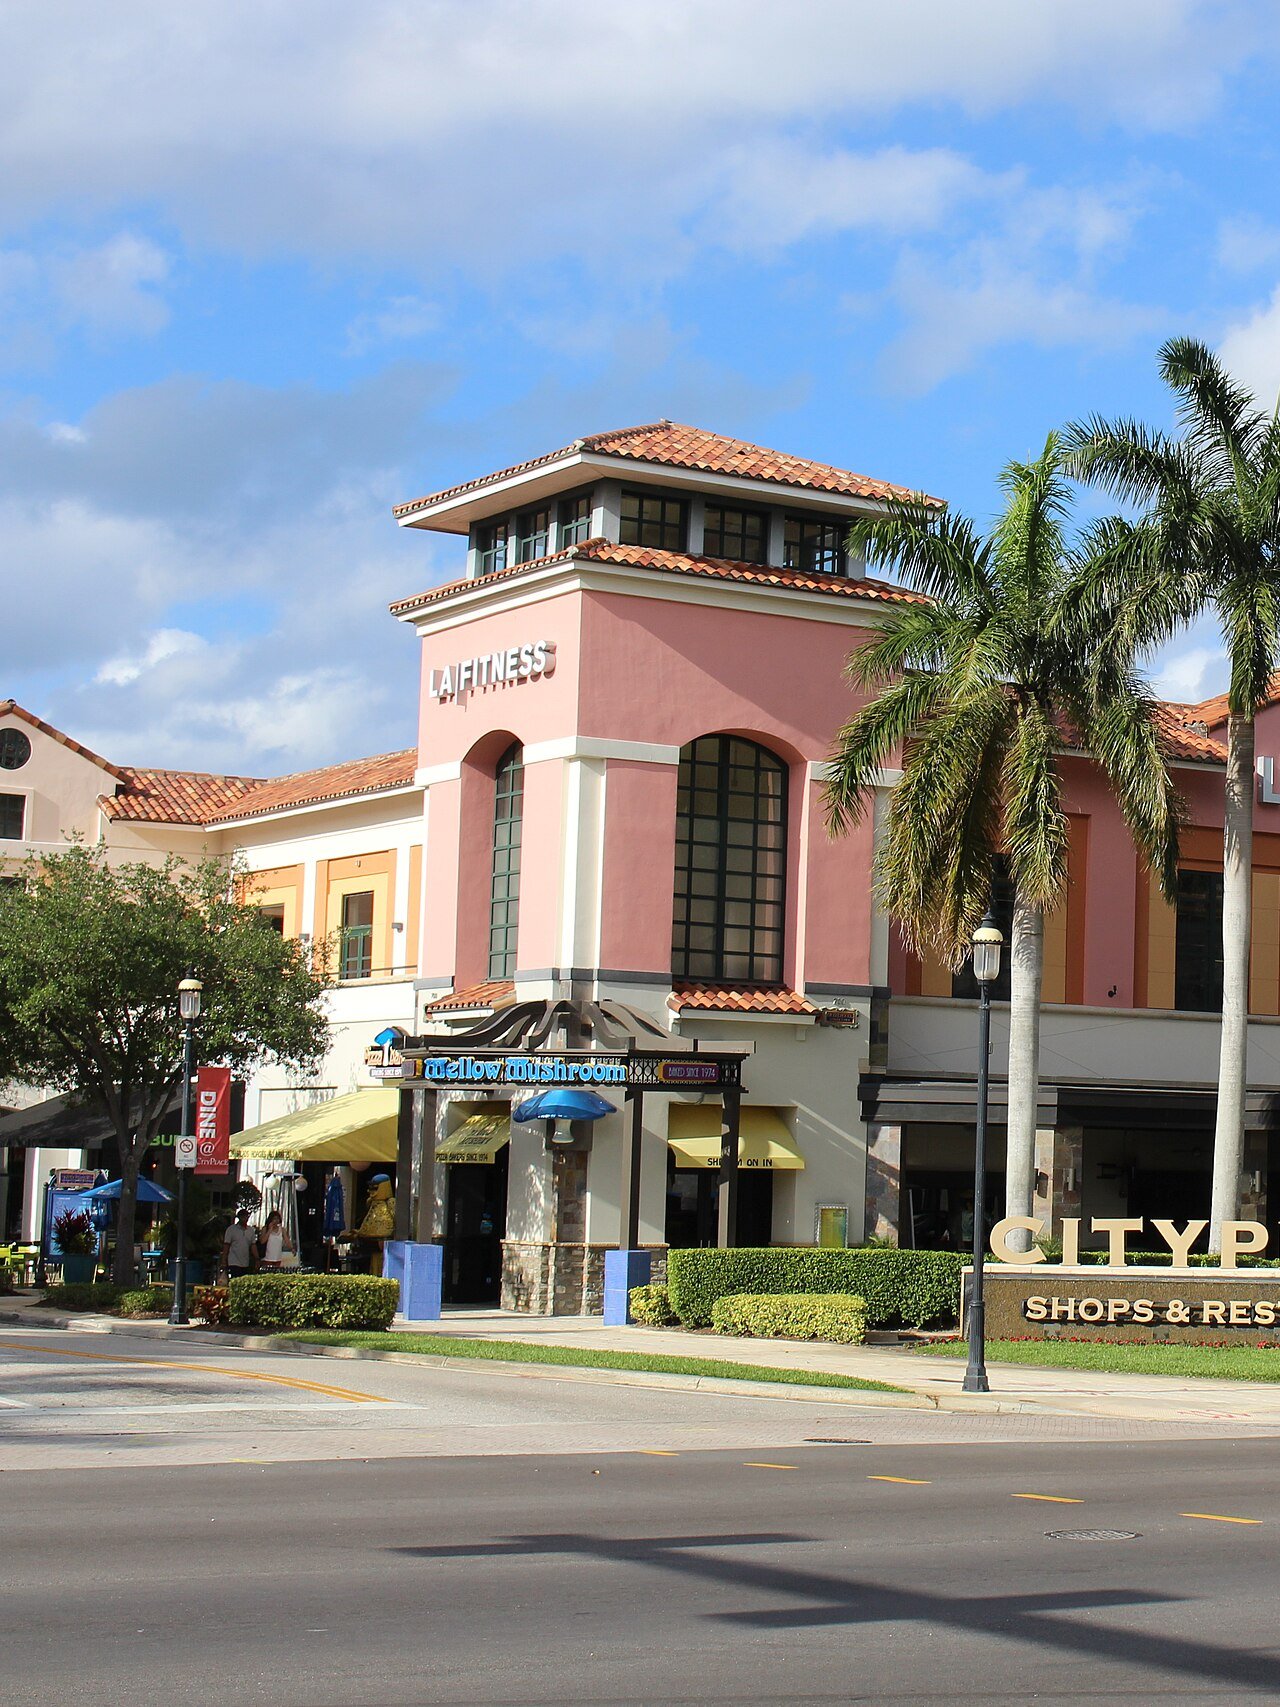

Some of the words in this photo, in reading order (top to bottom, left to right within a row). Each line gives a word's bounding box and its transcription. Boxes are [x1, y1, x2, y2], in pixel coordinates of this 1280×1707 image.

[429, 665, 454, 699] LA
[459, 640, 553, 691] FITNESS
[424, 1056, 501, 1080] Mellow
[505, 1056, 628, 1082] Mushroom
[701, 1067, 716, 1078] 1974
[200, 1091, 217, 1139] DINE
[200, 1141, 215, 1157] @
[746, 1158, 759, 1167] ON
[762, 1158, 773, 1167] IN
[1025, 1295, 1156, 1324] SHOPS
[1165, 1299, 1190, 1324] &
